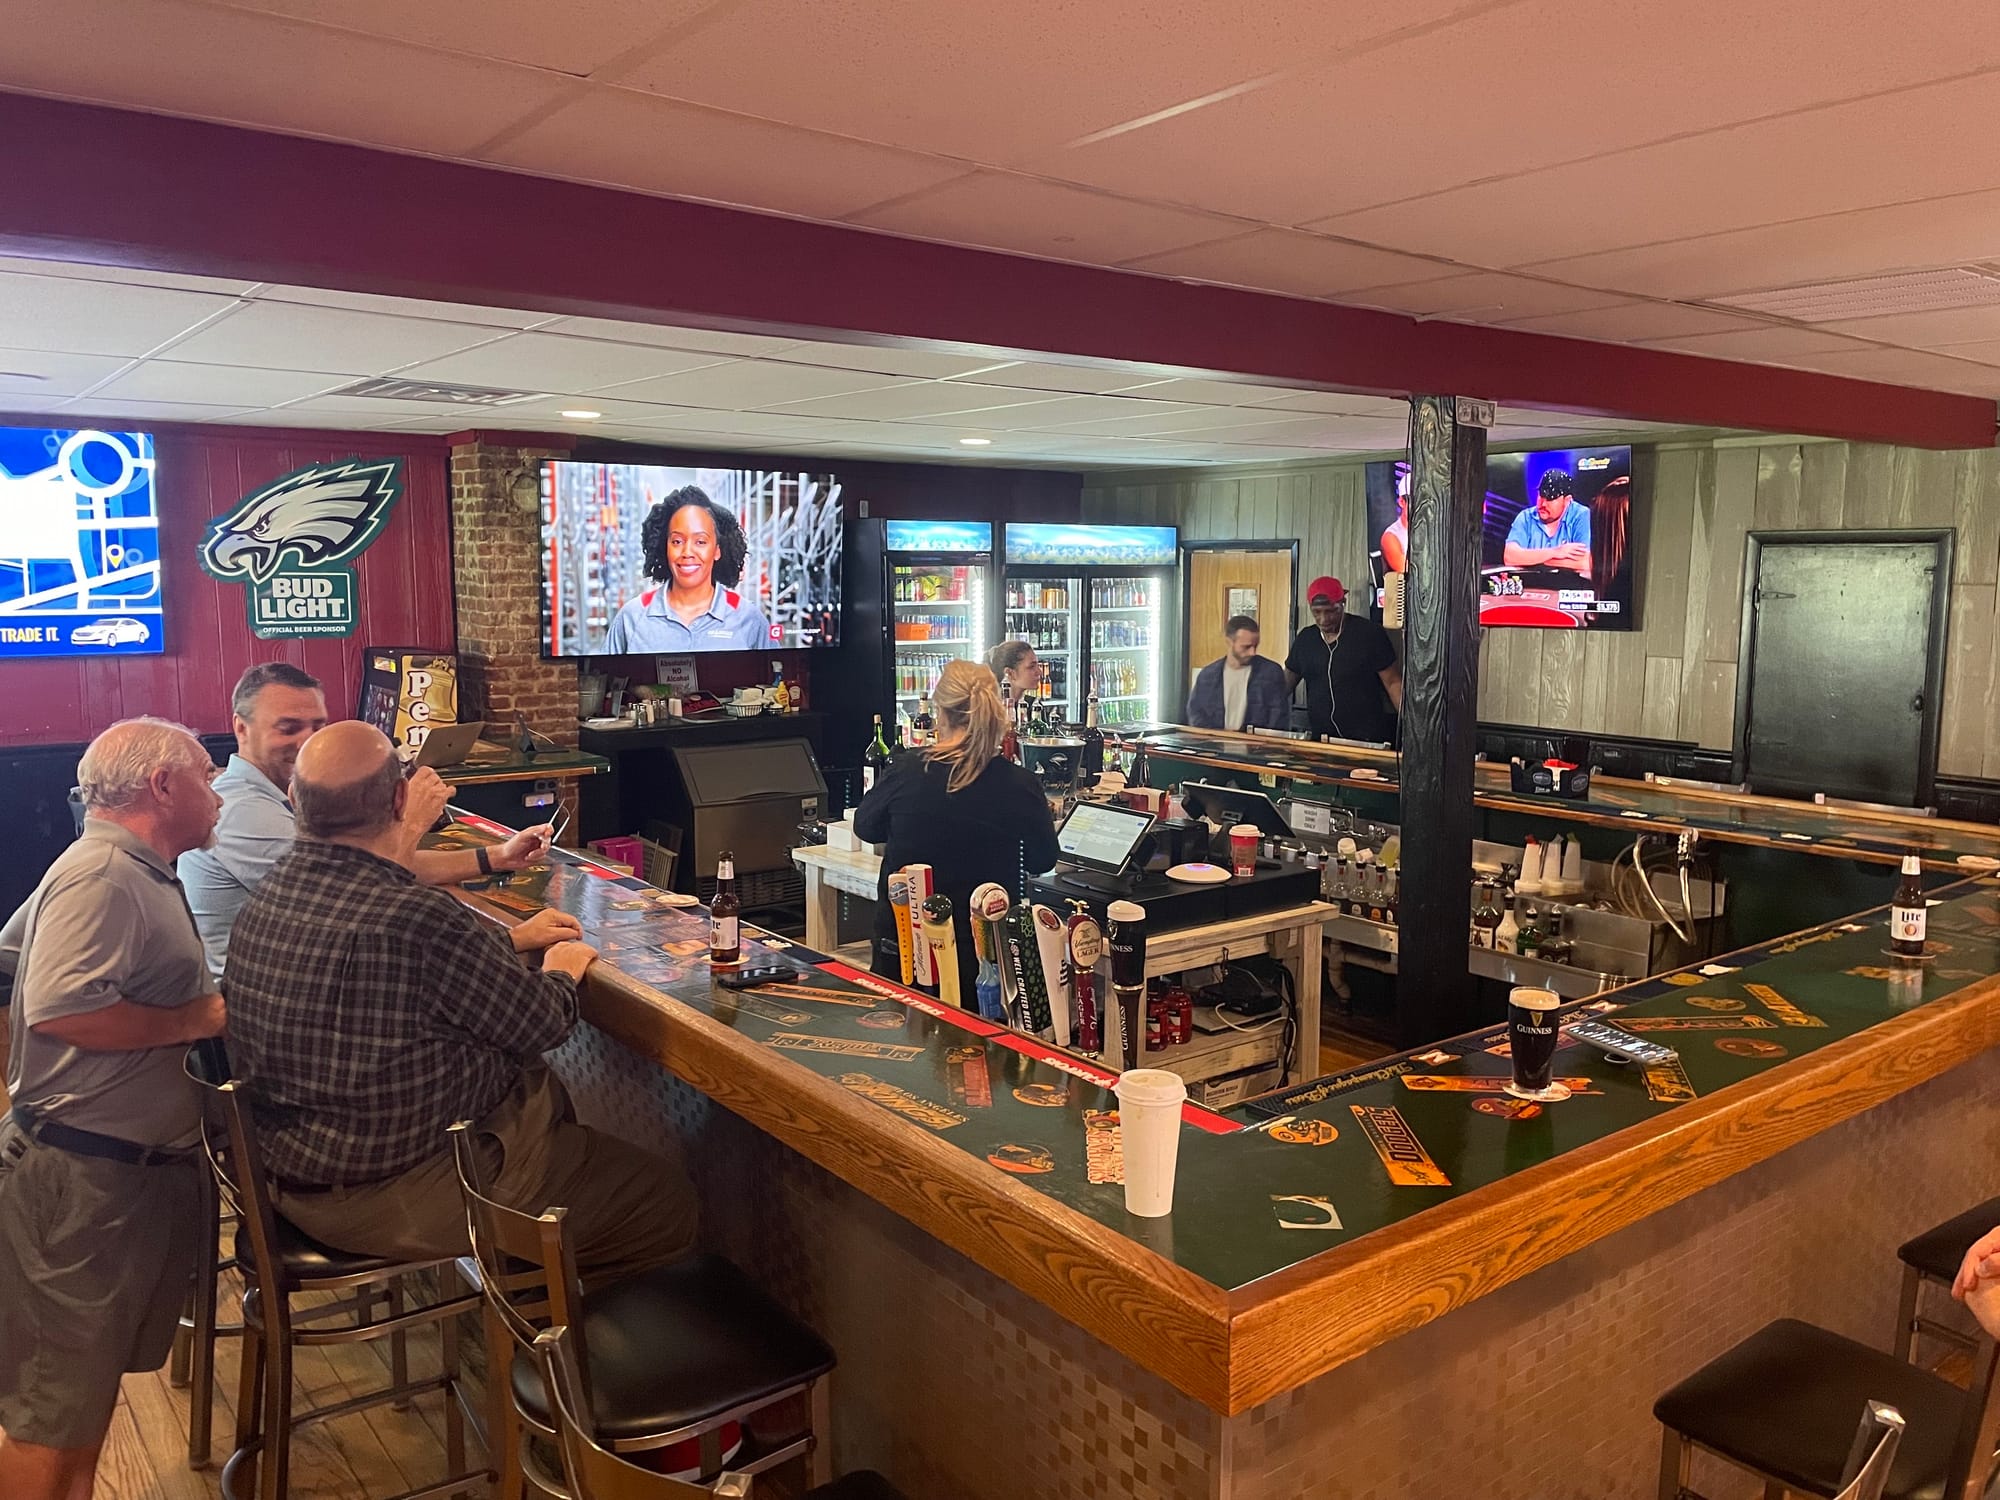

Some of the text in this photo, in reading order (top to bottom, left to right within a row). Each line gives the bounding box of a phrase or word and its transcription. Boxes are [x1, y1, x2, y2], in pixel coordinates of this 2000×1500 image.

[272, 578, 333, 598] BUD
[261, 598, 344, 618] LIGHT
[0, 627, 43, 643] TRADE
[262, 626, 294, 634] OFFICIAL
[313, 625, 346, 633] SPONSOR
[407, 670, 433, 757] Pen
[909, 876, 919, 920] ULTRA
[712, 919, 721, 930] te
[1076, 949, 1100, 959] LAGER
[1013, 956, 1023, 976] WELL
[1016, 976, 1029, 1010] CRAFTED
[1119, 1005, 1129, 1051] GUINNESS
[1516, 1023, 1553, 1035] GUINNESS
[920, 1099, 970, 1122] ANGELES
[1365, 1106, 1425, 1163] DODGERS
